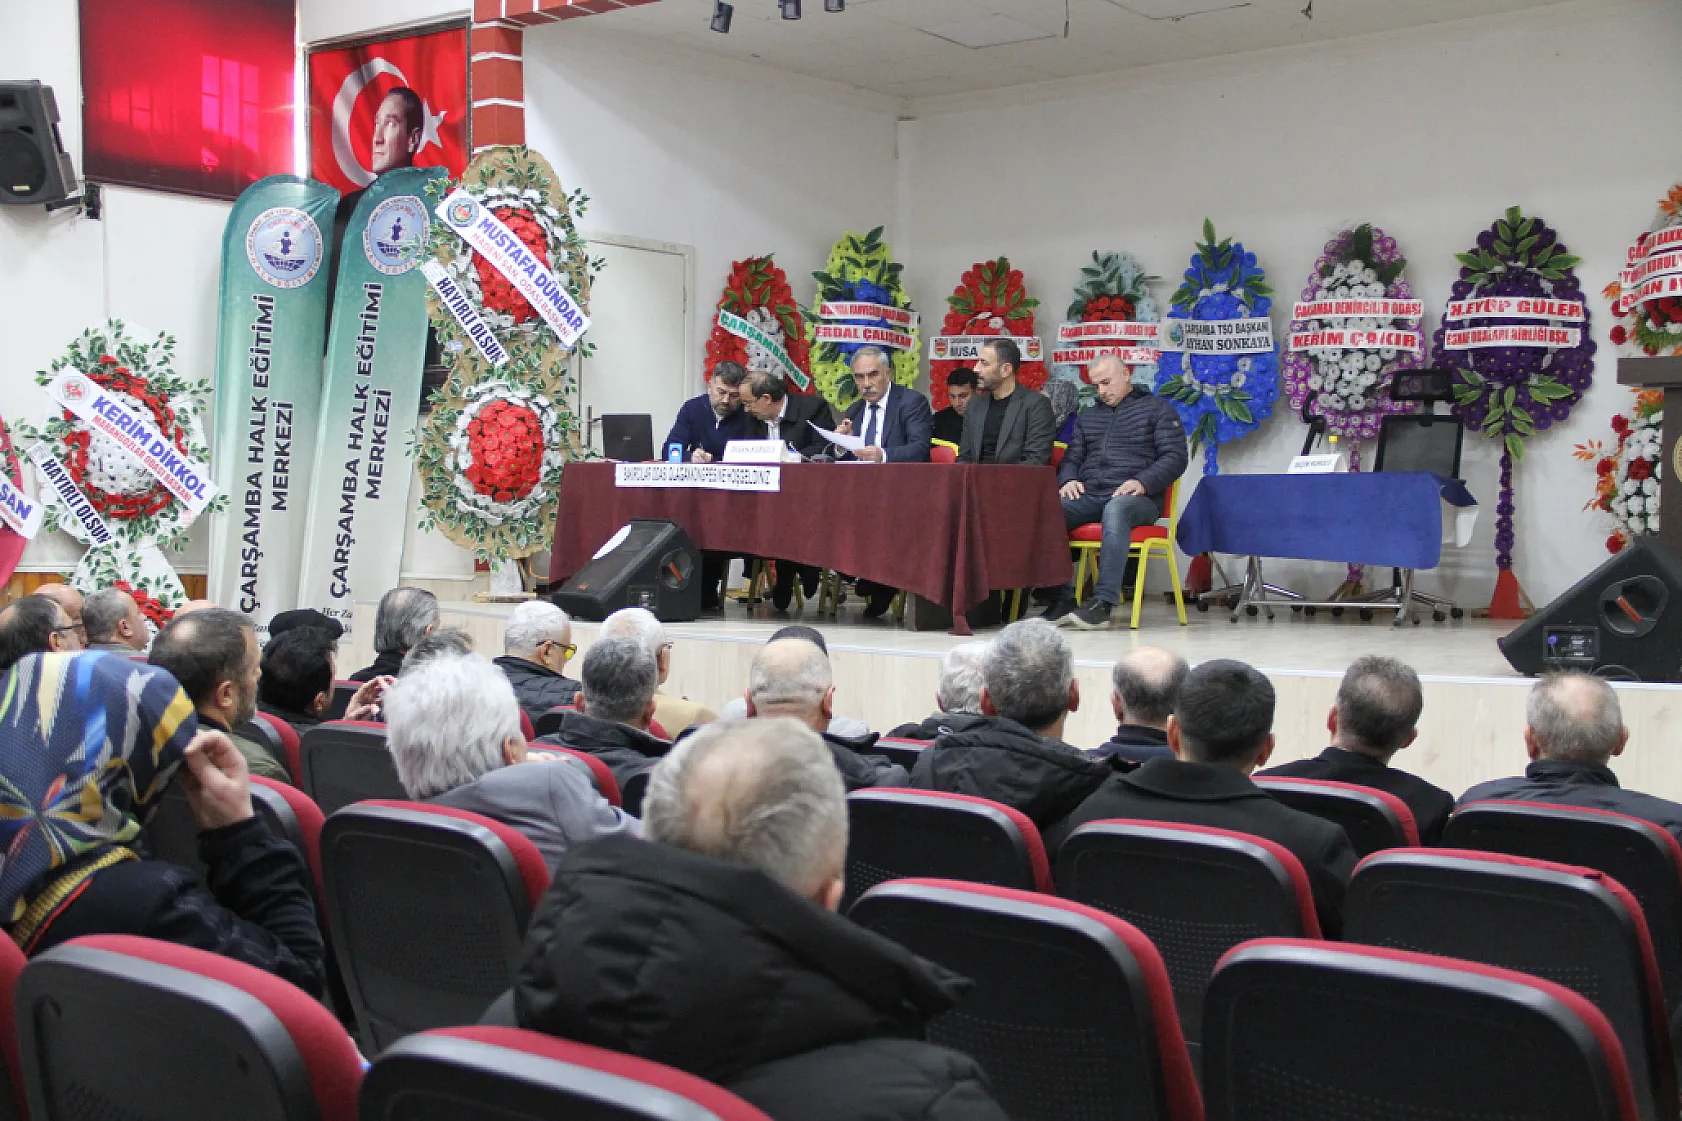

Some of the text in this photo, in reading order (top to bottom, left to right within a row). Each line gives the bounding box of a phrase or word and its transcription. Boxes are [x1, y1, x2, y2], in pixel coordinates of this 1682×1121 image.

[477, 216, 584, 333] MUSTAFA DÜNDAR
[519, 278, 544, 304] ODASI
[540, 303, 571, 337] BAŞKANI
[1516, 299, 1581, 317] GÜLER
[249, 294, 275, 389] EĞİTİMİ
[436, 276, 506, 363] HAYIRLI OLSUN
[815, 326, 913, 348] ERDAL ÇALIŞKAN
[1053, 349, 1096, 363] HASAN
[1217, 324, 1233, 334] TSO
[1235, 322, 1269, 335] BAŞKANI
[1217, 336, 1271, 350] SONKAYA
[1293, 331, 1344, 348] KERİM
[91, 396, 207, 501] KERİM DİKKOL
[247, 396, 269, 463] HALK
[271, 401, 294, 511] MERKEZİ
[330, 283, 382, 599] ÇARŞAMBA HALK EĞİTİMİ
[365, 389, 392, 499] MERKEZİ
[41, 458, 112, 544] HAYIRLI OLSUN
[239, 471, 264, 614] ÇARŞAMBA
